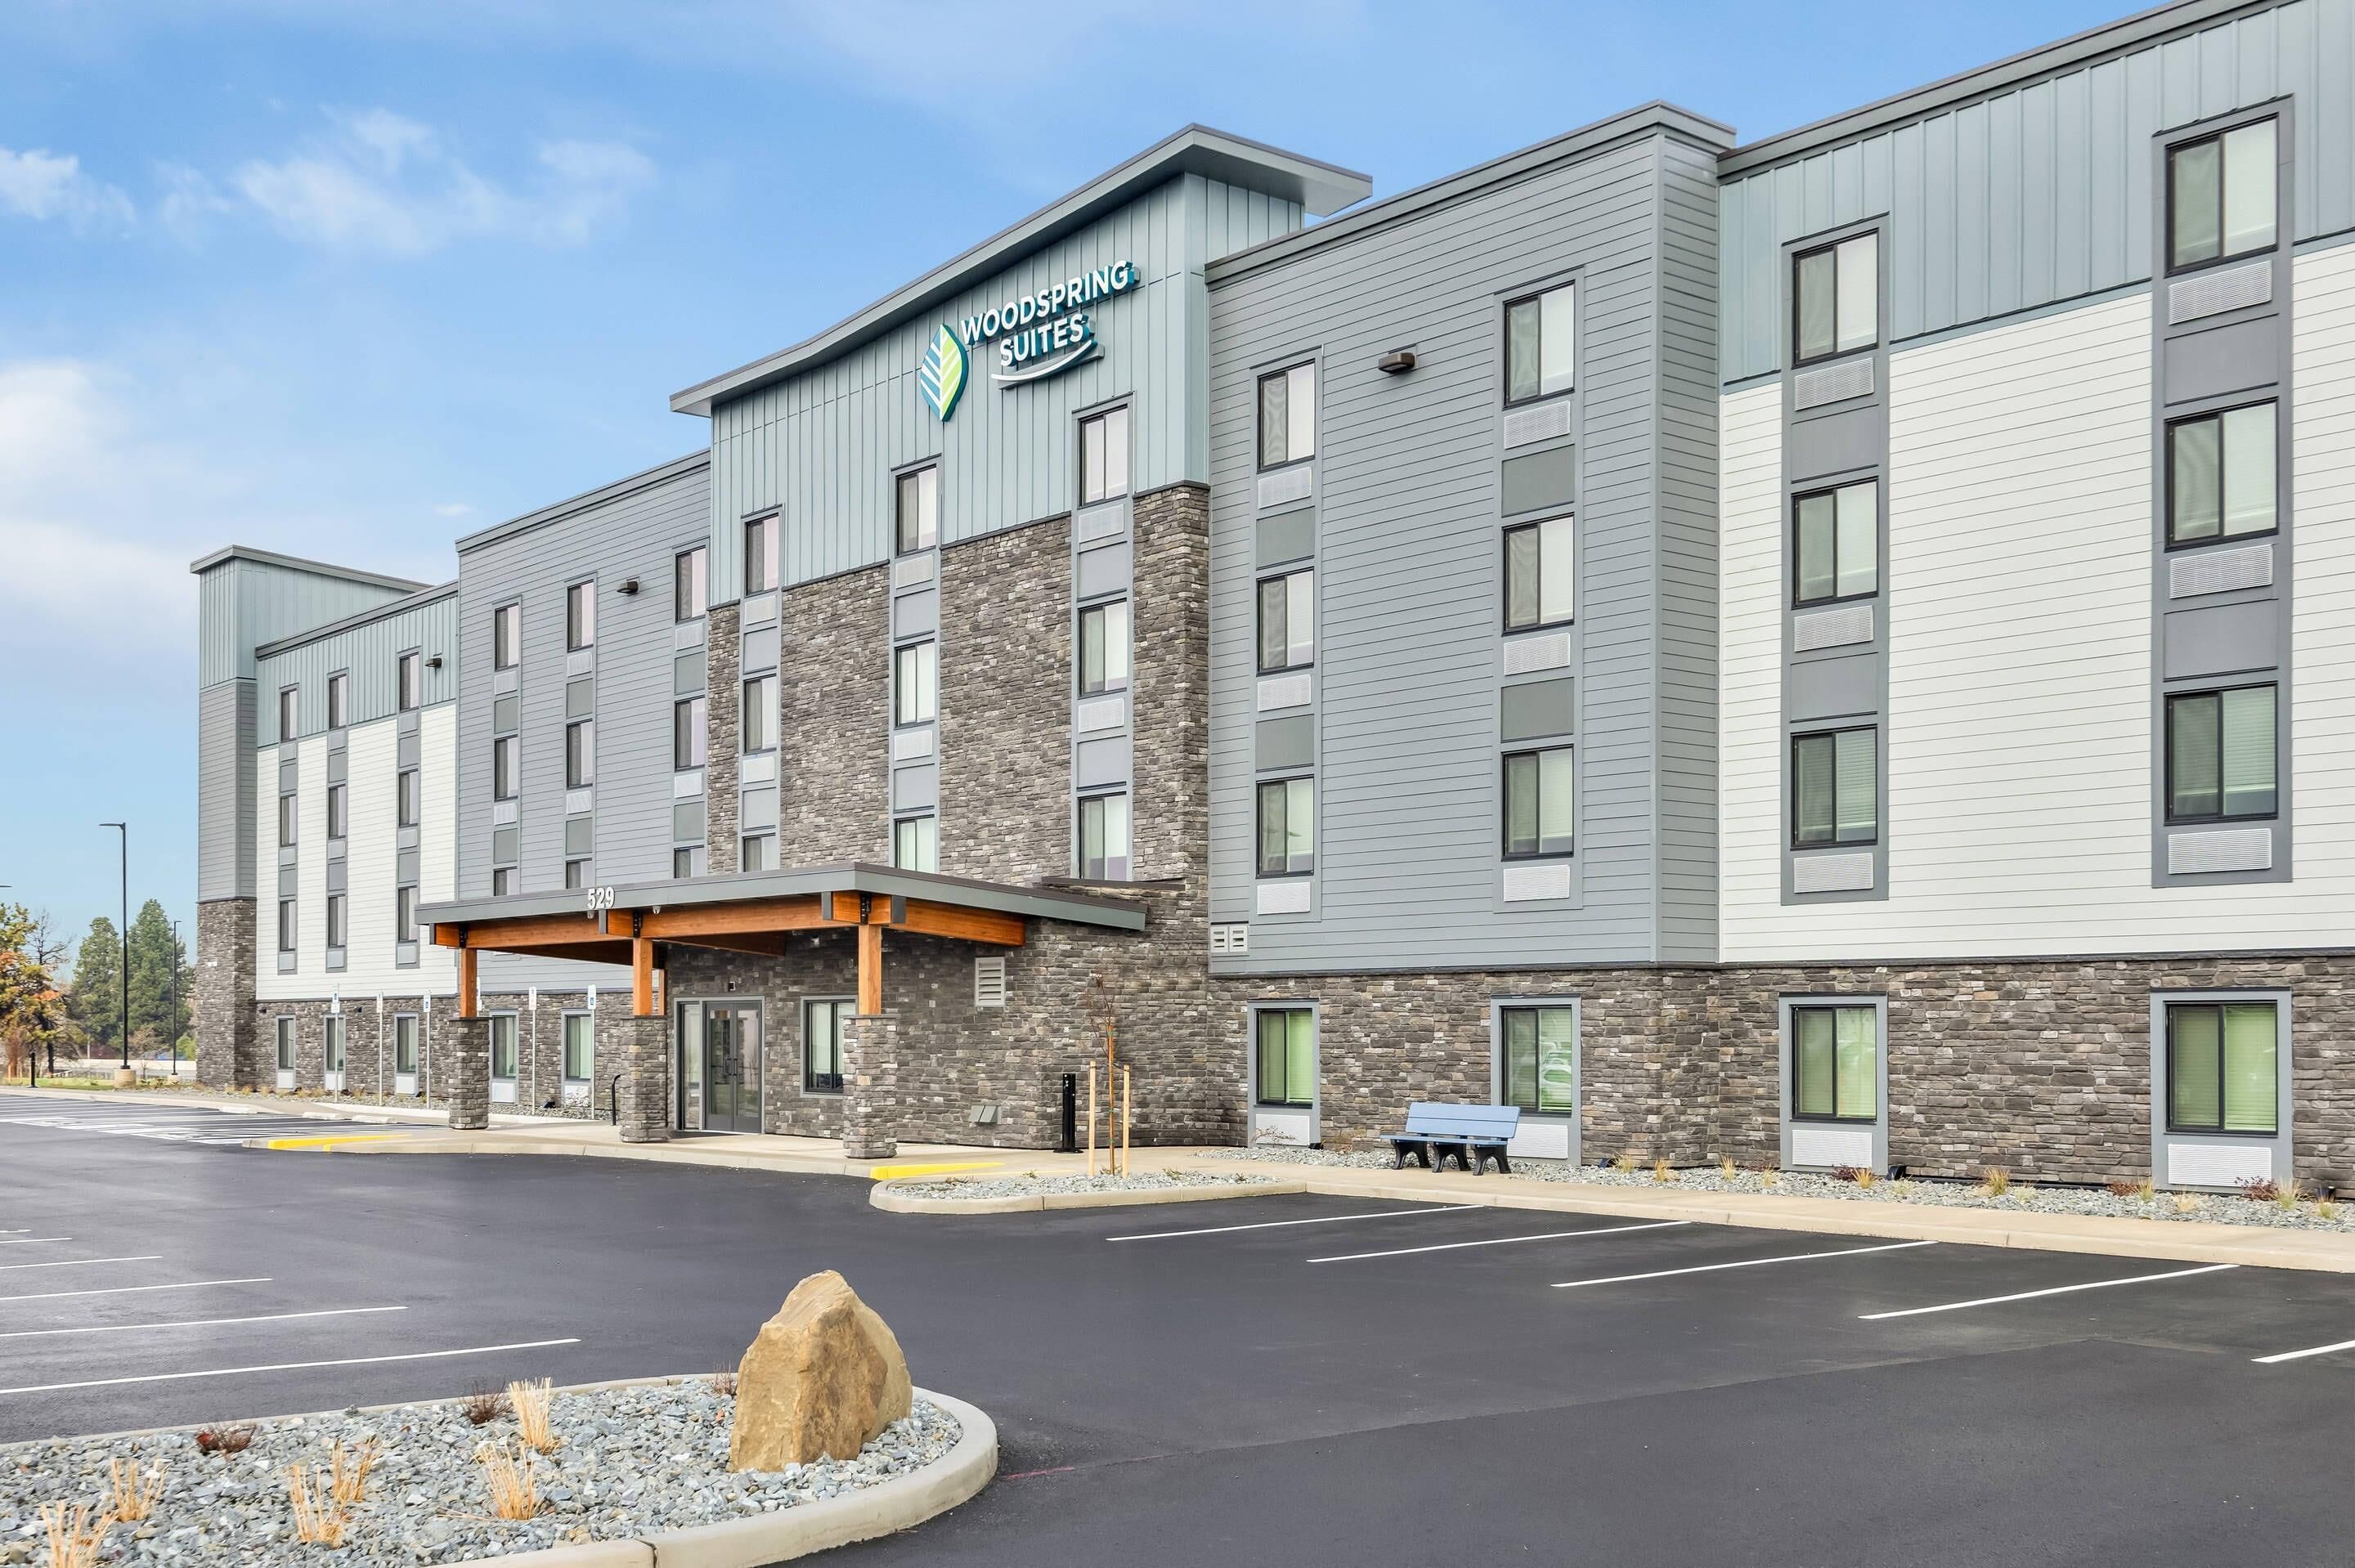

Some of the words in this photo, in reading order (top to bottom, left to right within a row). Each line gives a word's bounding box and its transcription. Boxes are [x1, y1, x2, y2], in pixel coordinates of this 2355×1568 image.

[961, 260, 1133, 345] WOODSPRING
[999, 313, 1089, 366] SUITES
[587, 886, 614, 909] 529
